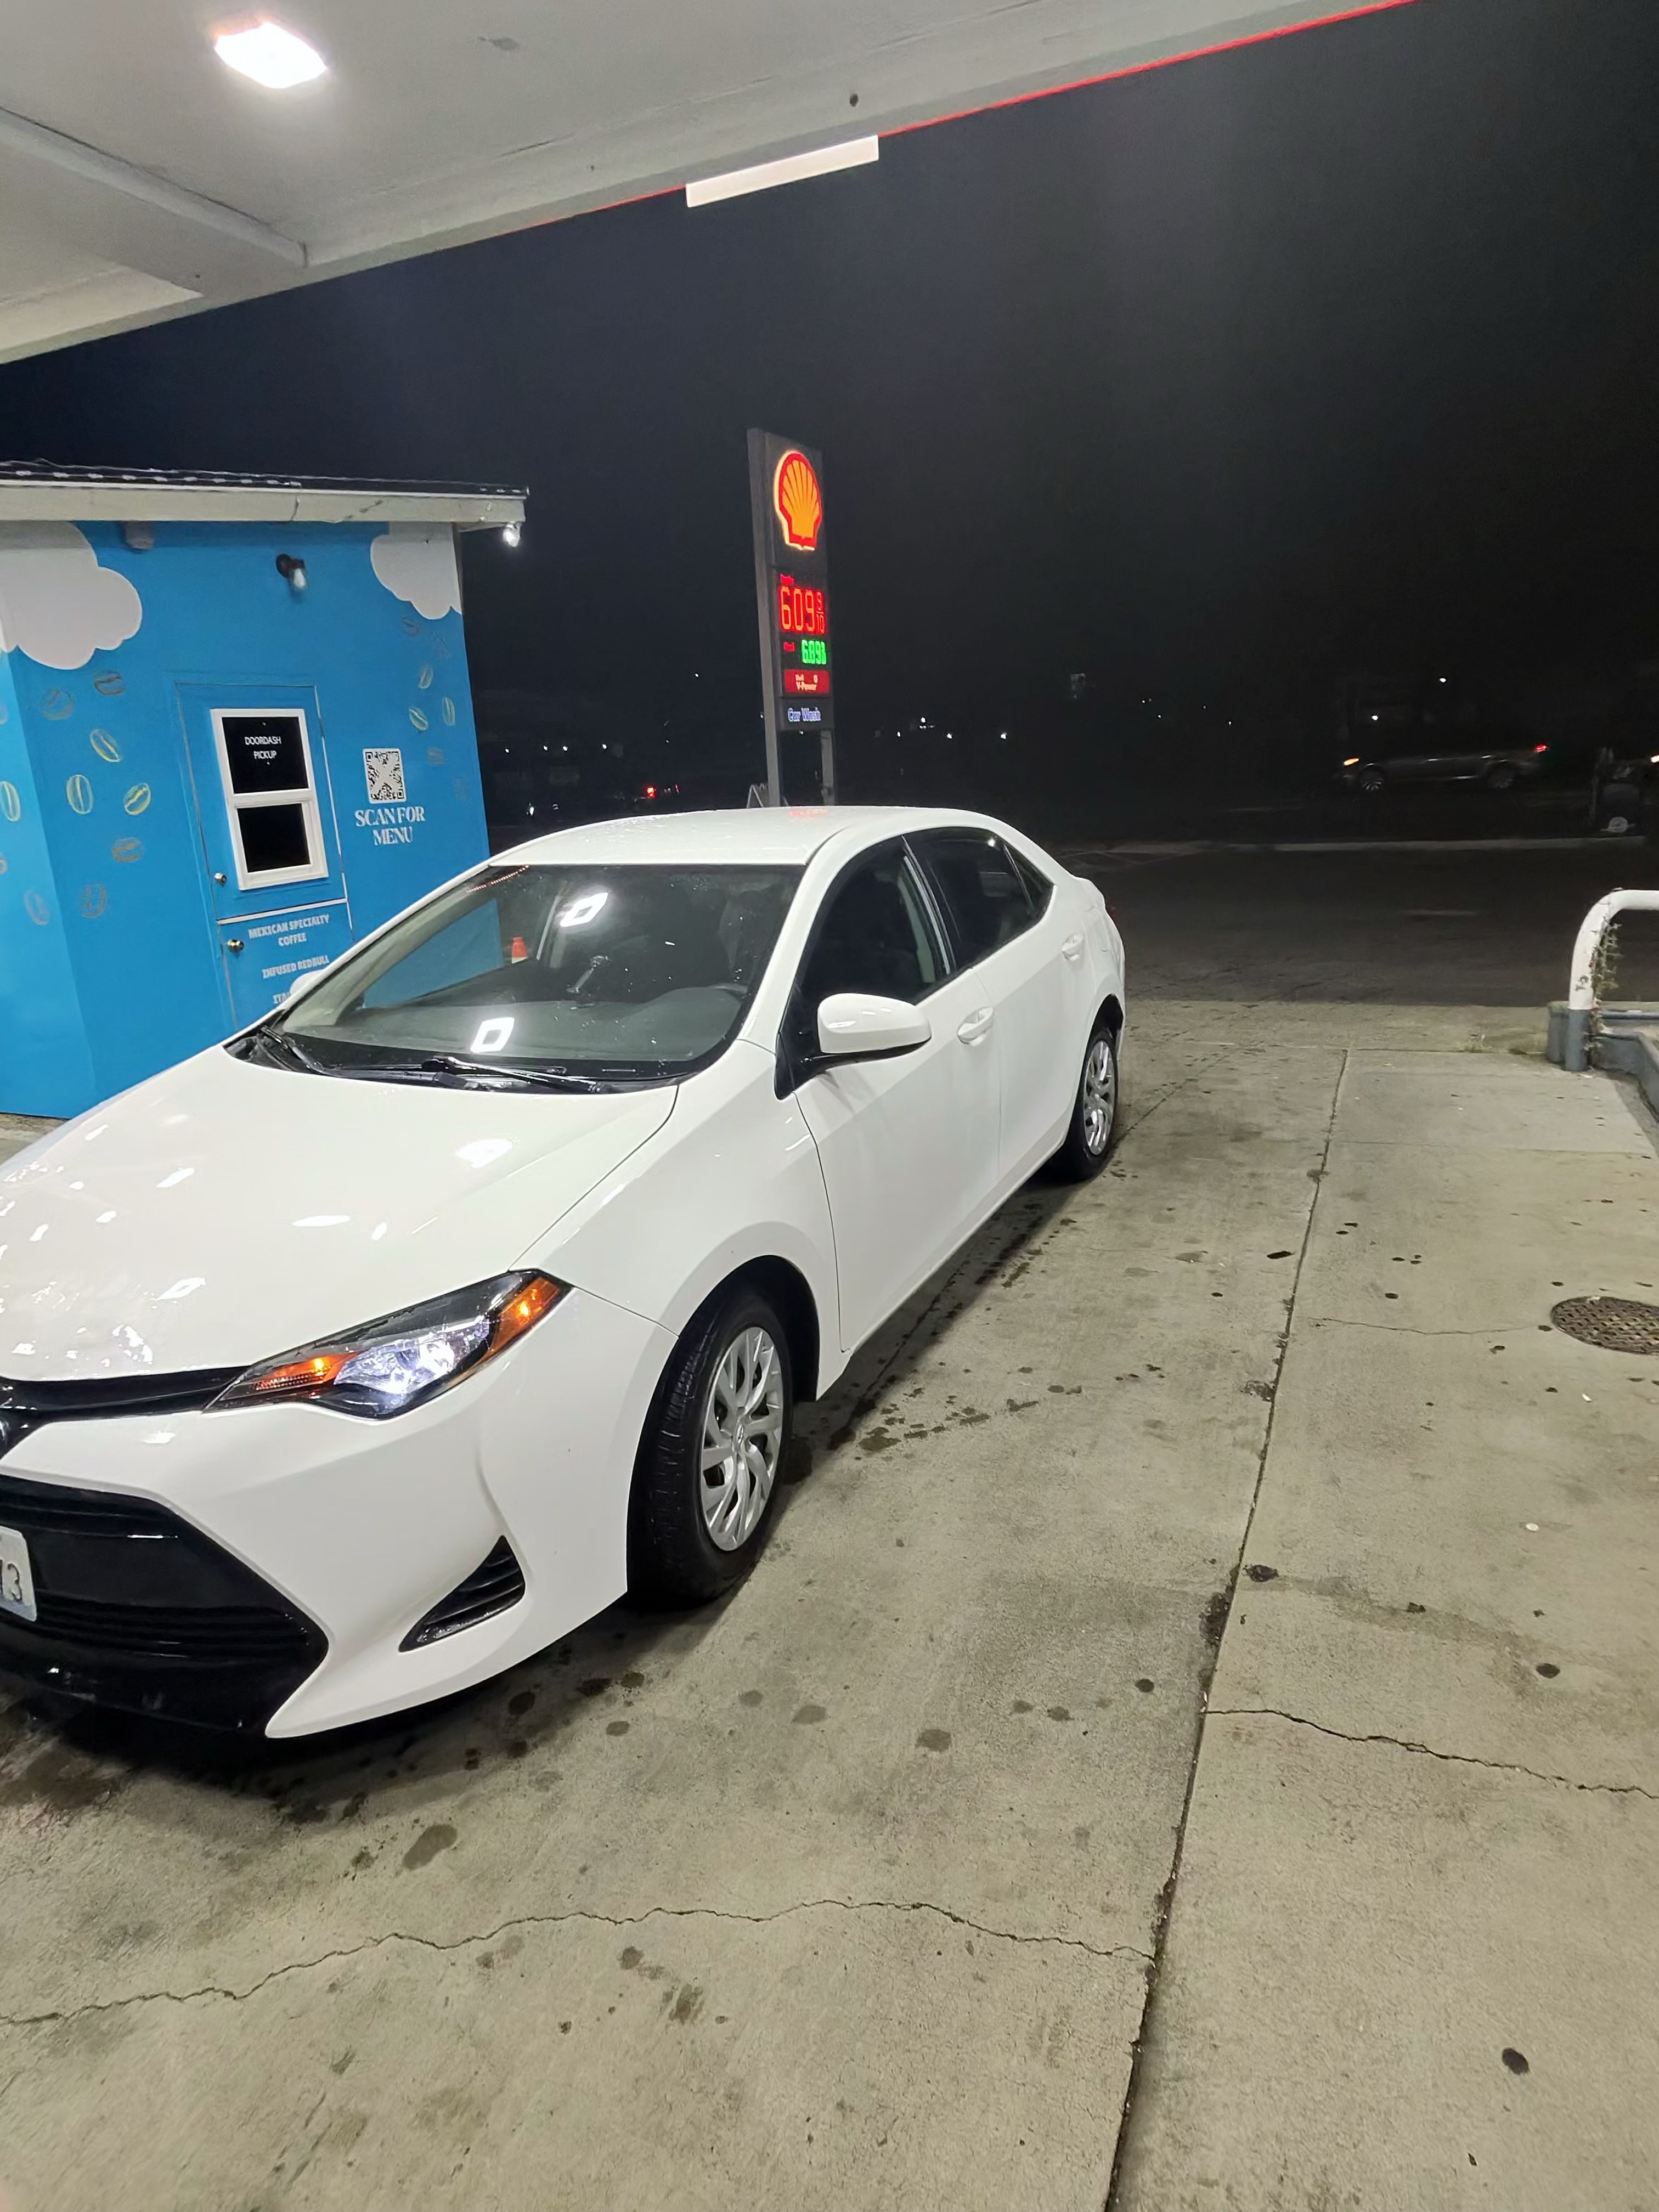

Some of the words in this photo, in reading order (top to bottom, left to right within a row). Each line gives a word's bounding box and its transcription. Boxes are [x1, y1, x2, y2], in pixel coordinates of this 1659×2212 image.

[788, 708, 801, 722] Car
[801, 707, 821, 722] Wash
[244, 736, 281, 745] DOORDASH
[253, 750, 276, 759] PICKUP
[354, 808, 396, 827] SCAN
[396, 806, 426, 823] FOR
[373, 826, 413, 845] MENU
[248, 922, 289, 939] MEXICAN
[289, 913, 330, 930] SPECIALTY
[278, 933, 307, 946] COFFEE
[262, 962, 297, 979] INFUSED
